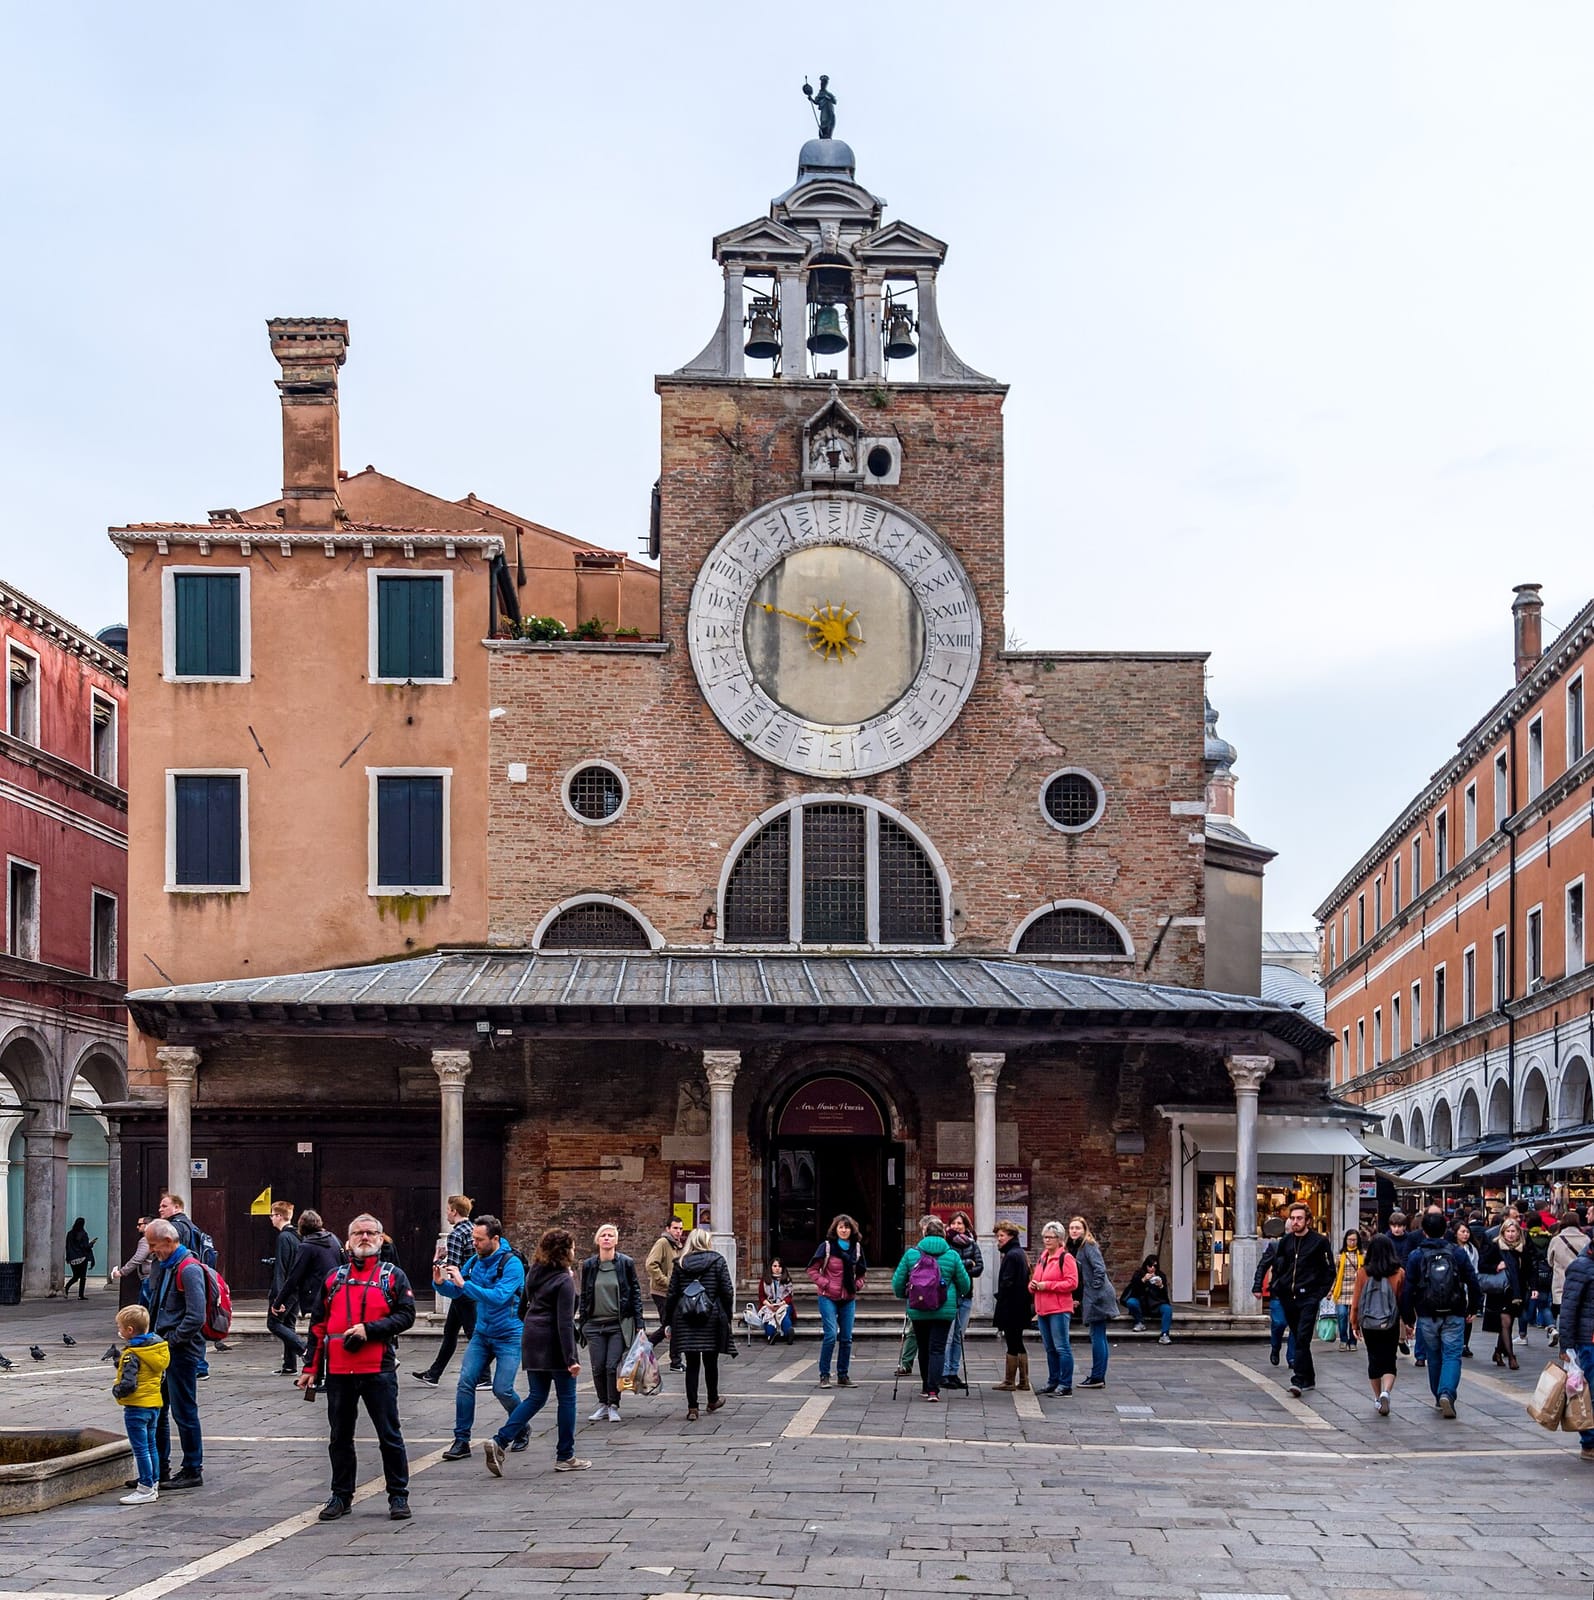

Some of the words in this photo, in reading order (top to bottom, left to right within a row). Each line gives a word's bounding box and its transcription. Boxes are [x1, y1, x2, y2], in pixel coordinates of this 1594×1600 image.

[794, 506, 815, 537] XVII
[828, 502, 842, 535] XVIII
[857, 506, 879, 544] XVIIII
[763, 518, 789, 548] XVI
[882, 528, 905, 554] XX
[738, 541, 763, 562] XV
[905, 545, 932, 572] XXI
[714, 560, 747, 586] XIIII
[921, 570, 955, 596] XXII
[708, 592, 736, 612] XIII
[932, 600, 968, 619] XXIII
[705, 625, 731, 639] XII
[935, 633, 972, 648] XXIIII
[711, 652, 731, 669] XI
[728, 682, 742, 696] X
[930, 689, 946, 706] II
[737, 703, 767, 729] VIIII
[764, 723, 788, 748] VIII
[796, 736, 814, 756] VII
[860, 741, 873, 752] V
[884, 727, 905, 750] IIII
[828, 741, 842, 758] VI
